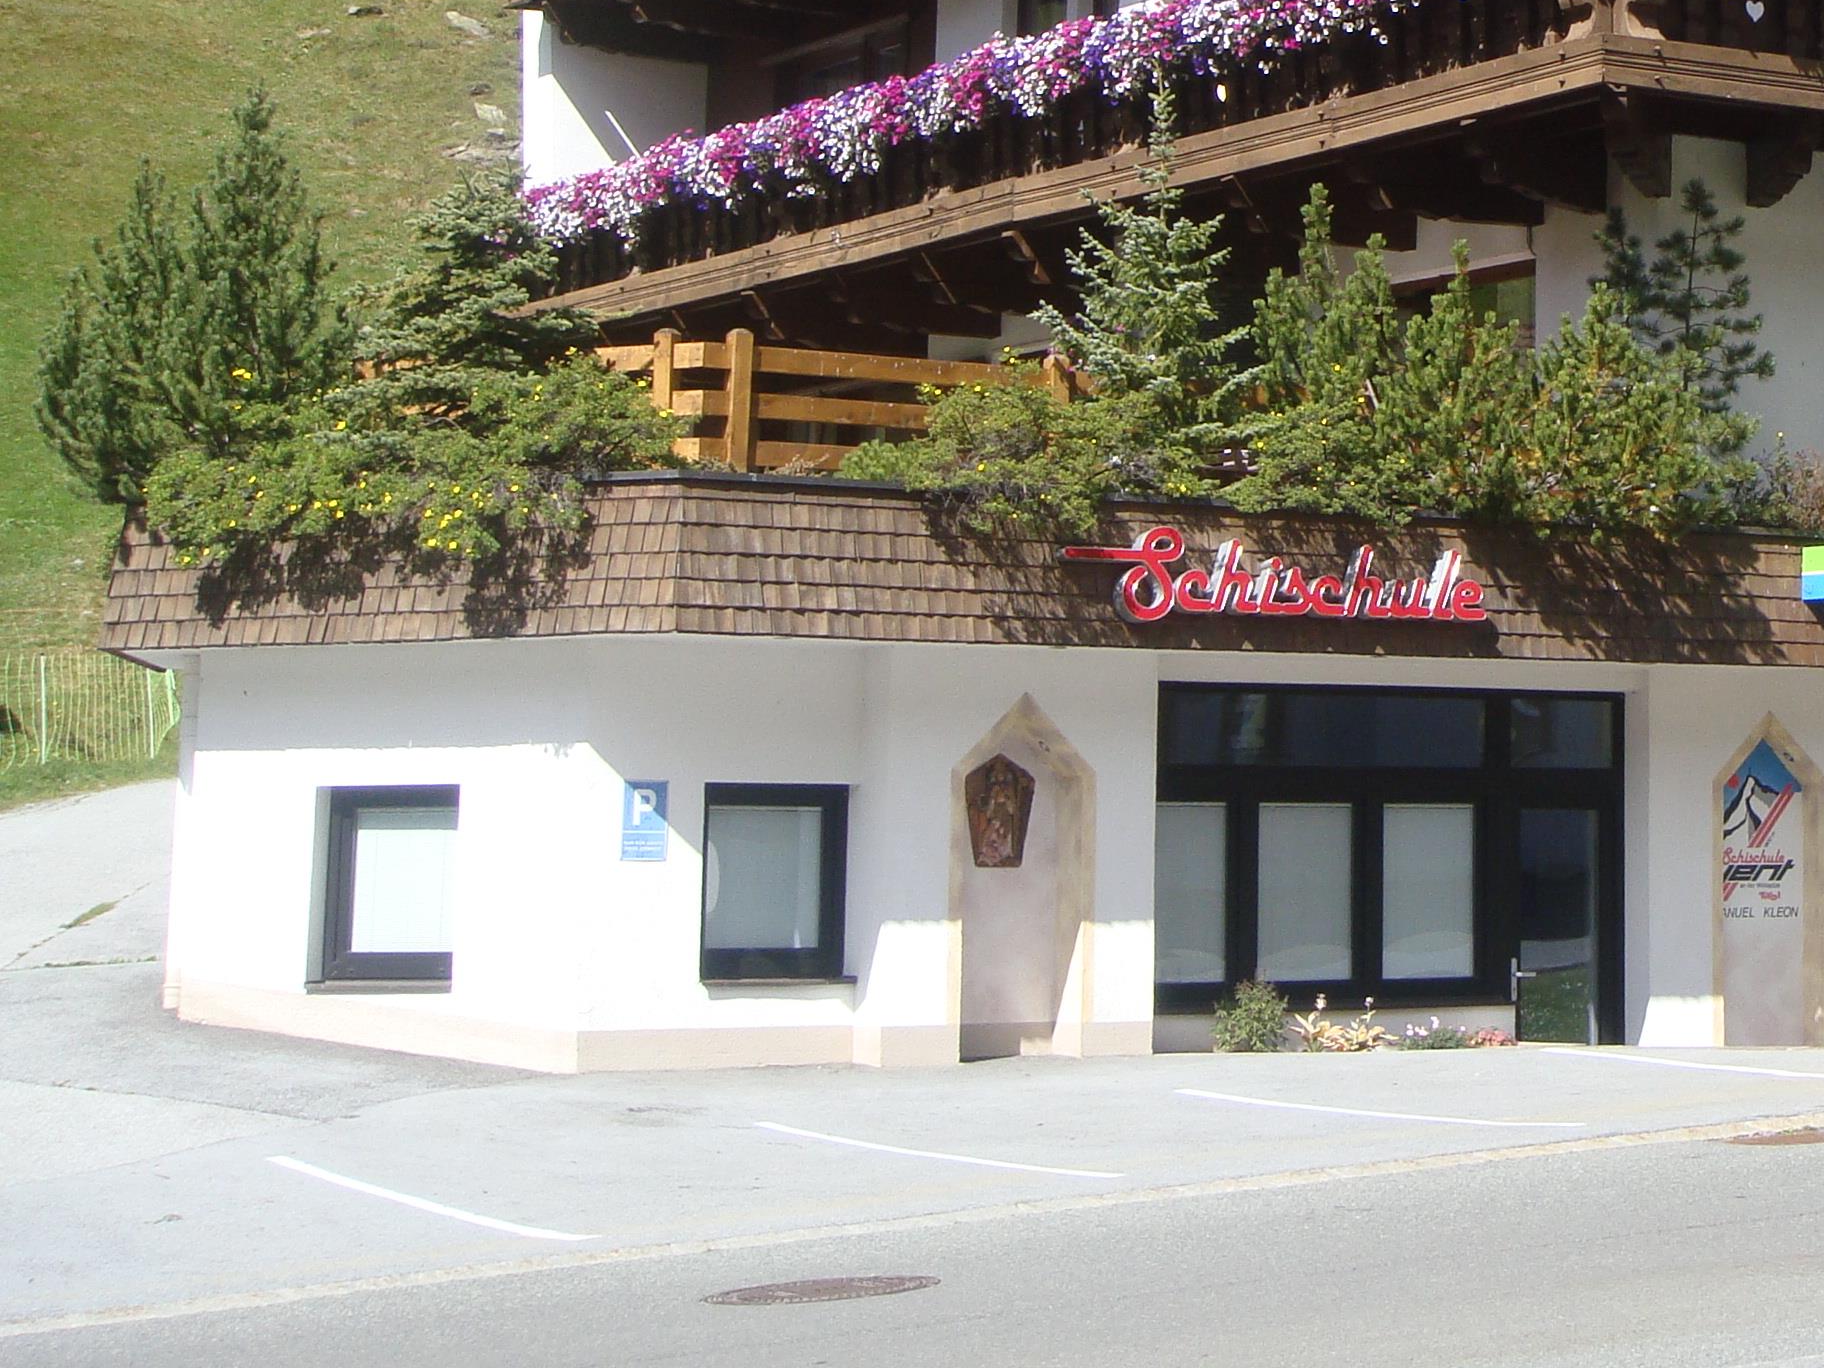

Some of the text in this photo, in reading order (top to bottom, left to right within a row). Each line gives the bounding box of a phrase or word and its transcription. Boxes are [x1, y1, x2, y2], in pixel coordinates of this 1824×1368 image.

[1060, 527, 1487, 622] Schischule
[632, 788, 657, 826] P
[1723, 846, 1785, 865] Schischule
[1763, 907, 1800, 918] KLEON
